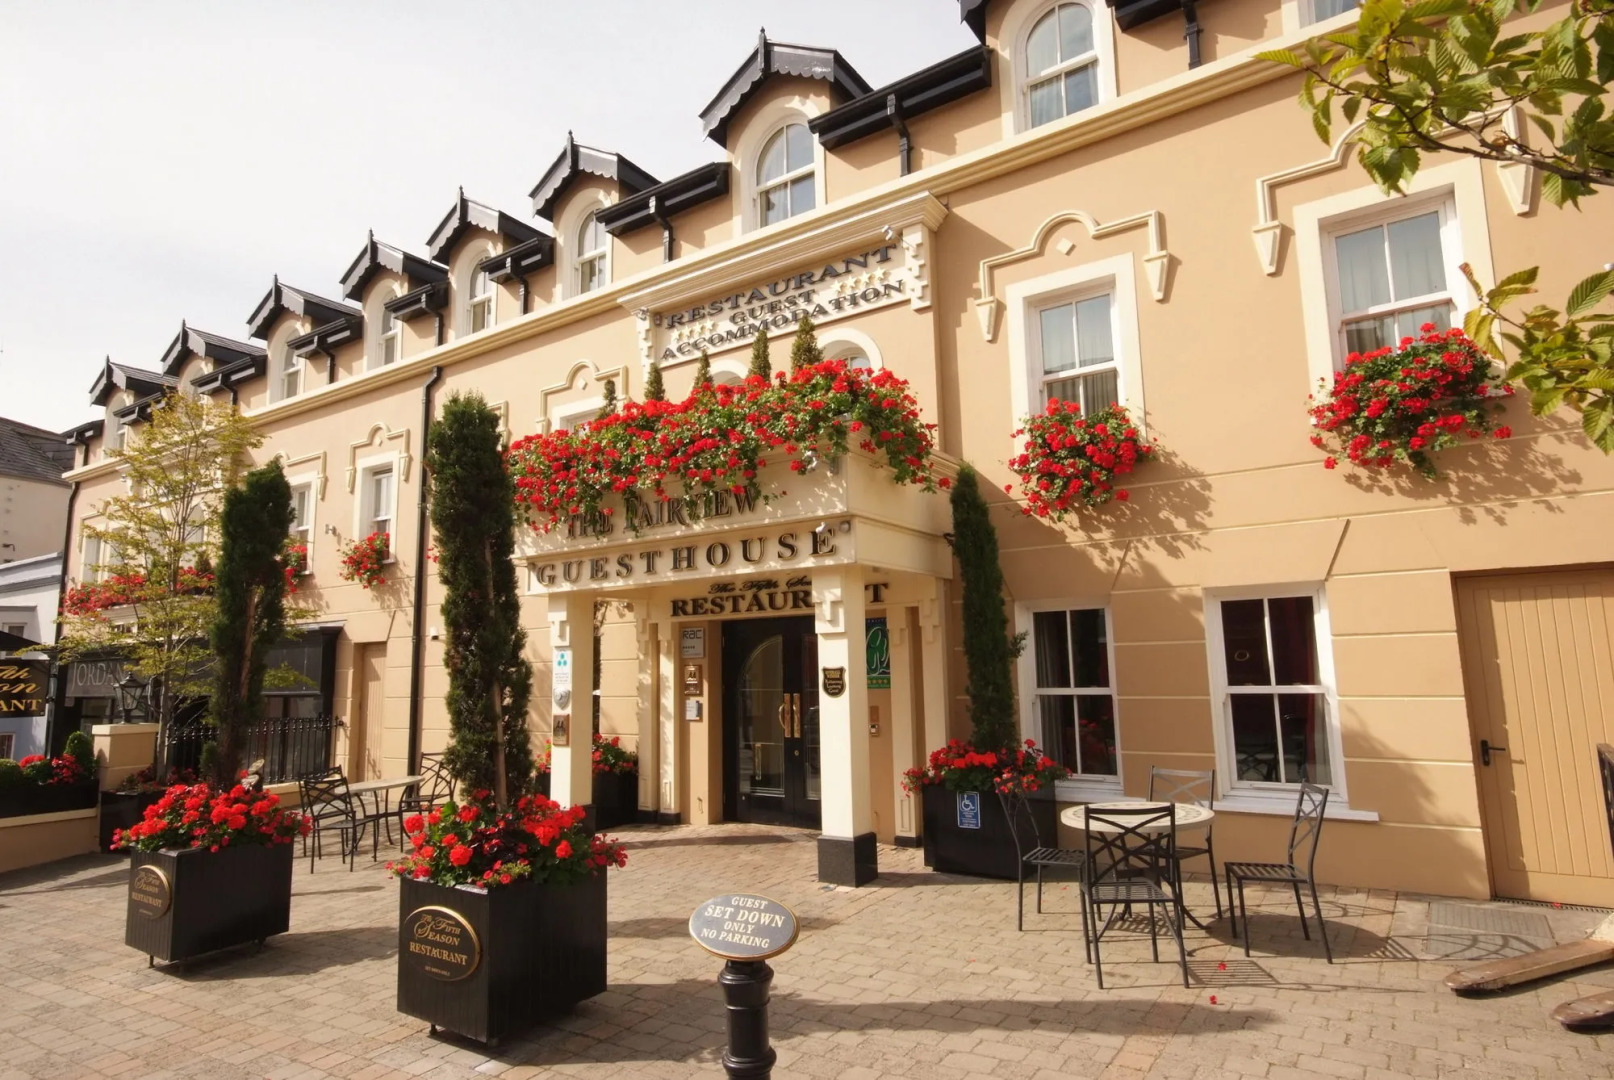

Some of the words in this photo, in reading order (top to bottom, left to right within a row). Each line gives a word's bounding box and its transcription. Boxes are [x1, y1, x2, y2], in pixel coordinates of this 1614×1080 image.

[665, 243, 897, 330] RESTAURANT
[661, 279, 904, 360] ACCOMMODATION
[729, 289, 816, 325] GUEST
[535, 528, 837, 587] GUESTHOUSE
[671, 582, 889, 617] RESTAURT
[705, 905, 734, 919] SET
[737, 910, 785, 928] DOWN
[732, 896, 768, 910] GUEST
[701, 928, 717, 939] NO
[719, 932, 770, 948] PARKING
[724, 921, 755, 934] ONLY
[409, 941, 468, 965] RESTAURANT
